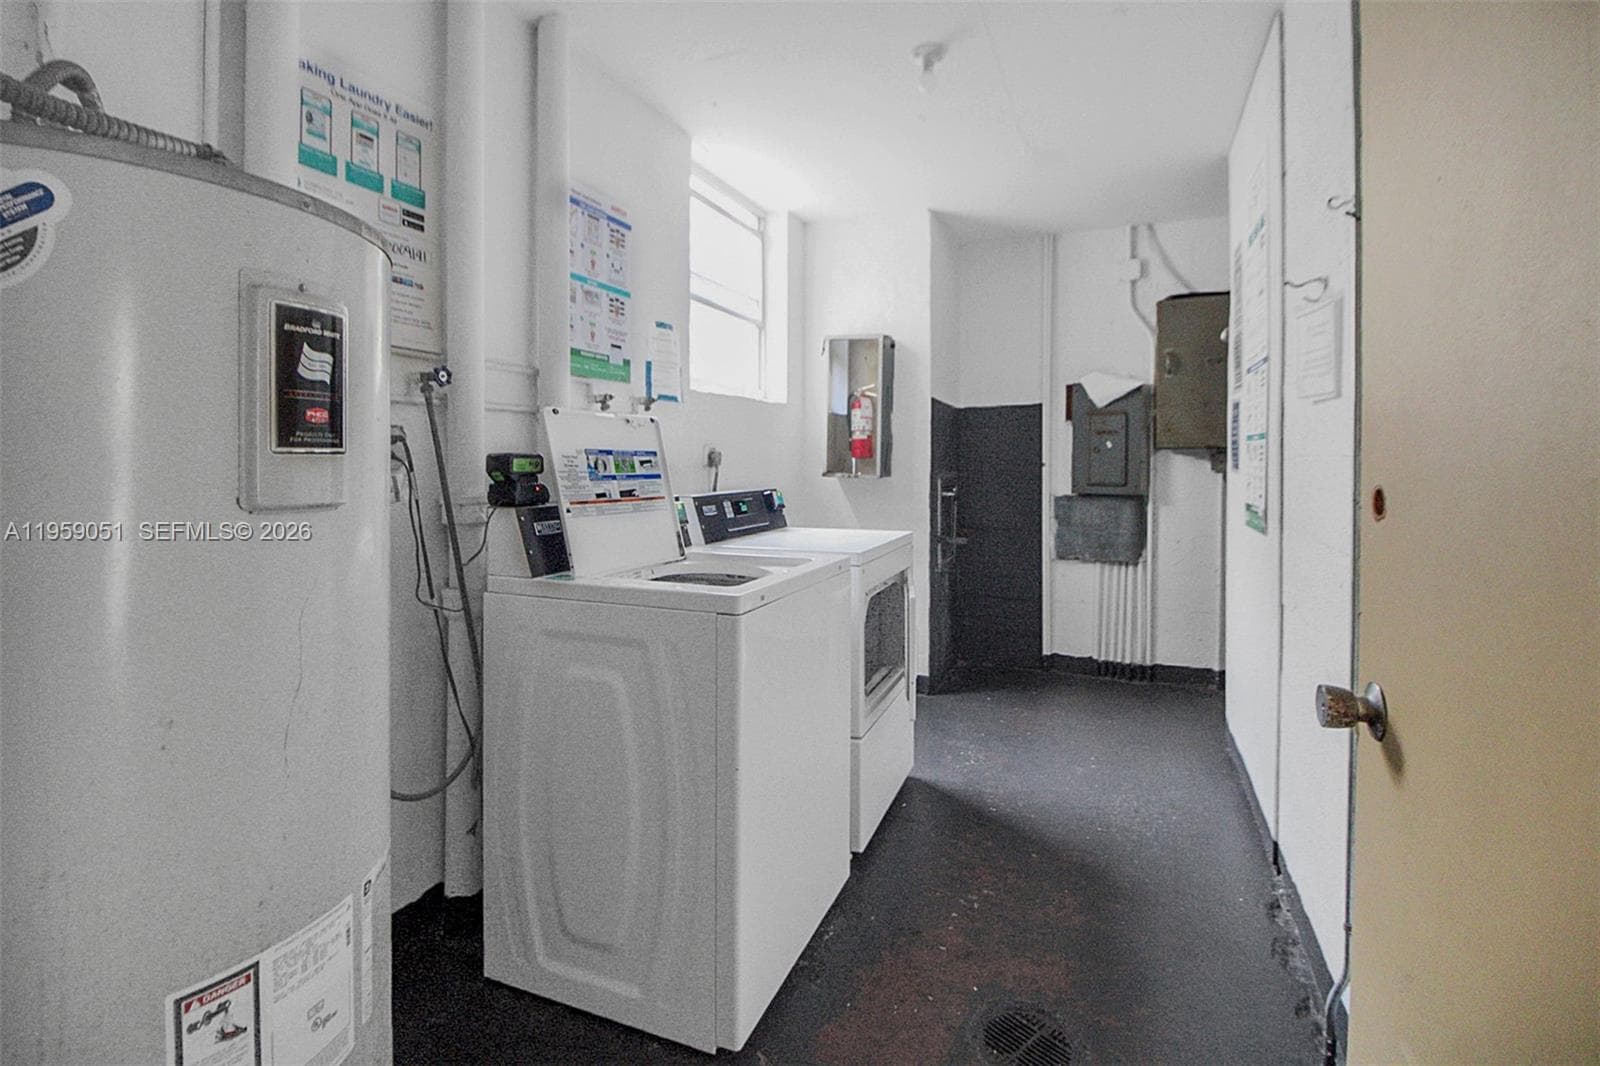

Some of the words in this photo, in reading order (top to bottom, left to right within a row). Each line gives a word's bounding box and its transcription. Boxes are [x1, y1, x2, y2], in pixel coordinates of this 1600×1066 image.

[298, 59, 336, 86] aking
[340, 77, 392, 112] Laundry
[202, 976, 247, 1004] DANGER
